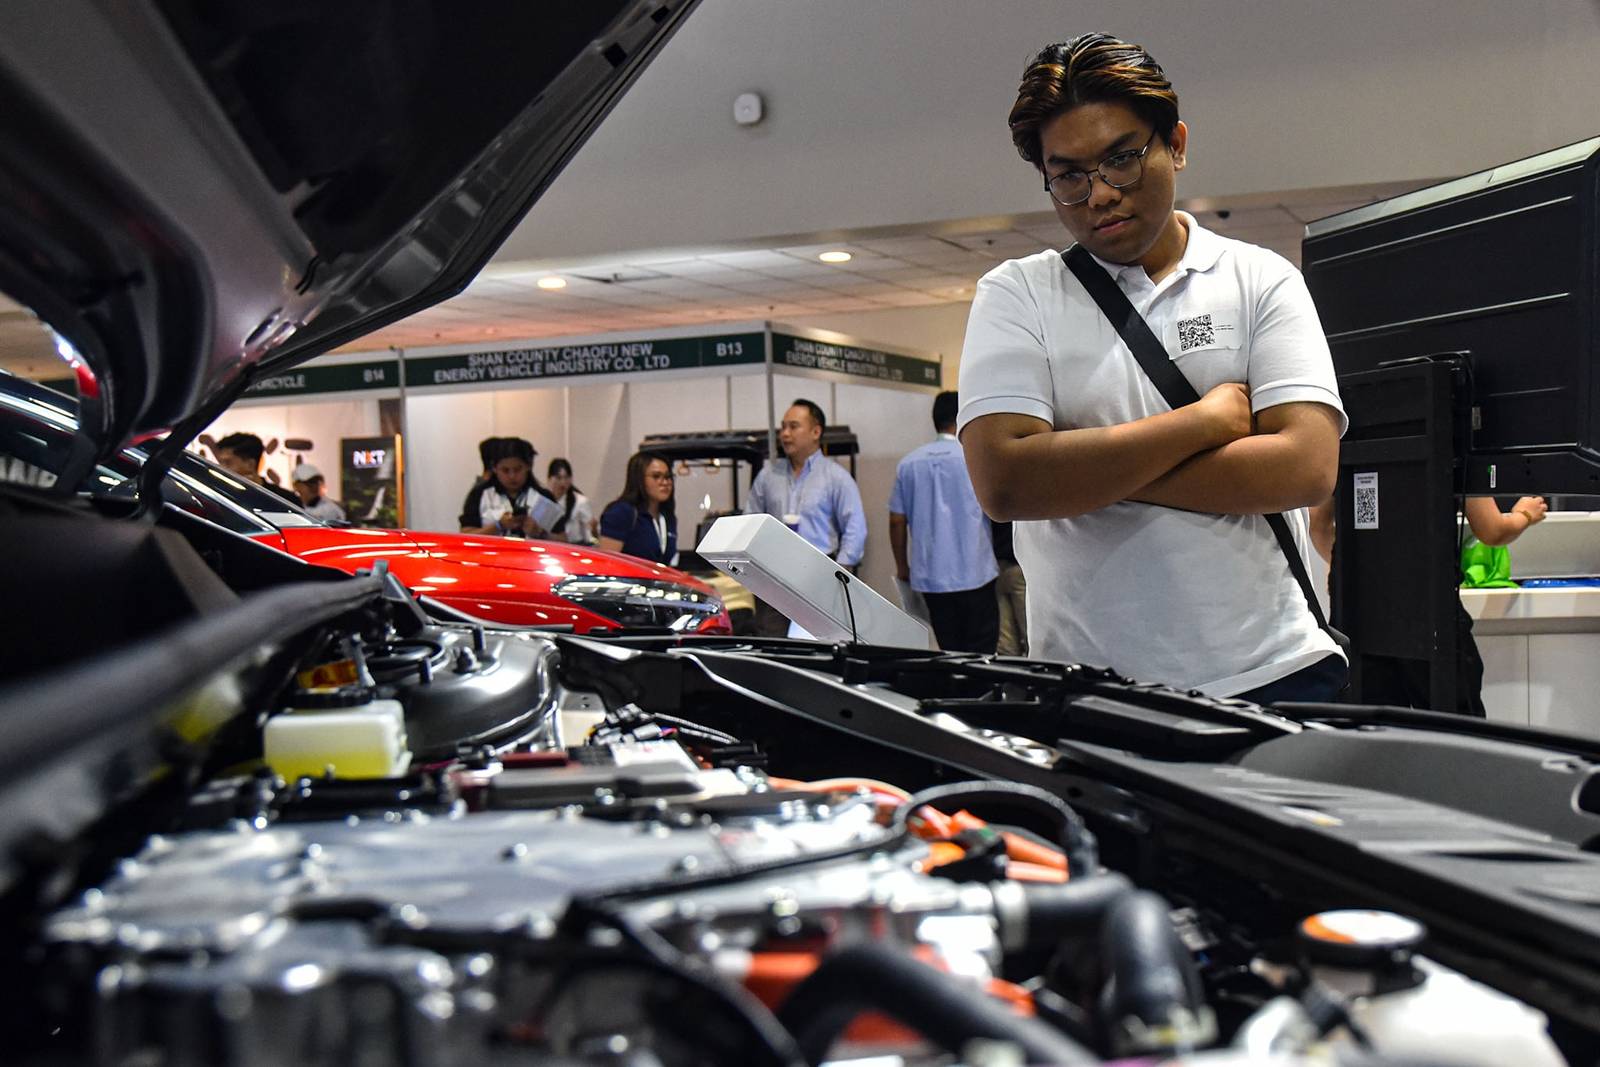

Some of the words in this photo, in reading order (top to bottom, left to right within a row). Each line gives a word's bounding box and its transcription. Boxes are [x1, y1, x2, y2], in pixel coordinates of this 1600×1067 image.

[468, 353, 503, 367] SHAN
[506, 349, 559, 364] COUNTY
[562, 345, 618, 361] CHAOFU
[621, 343, 653, 357] NEW
[716, 342, 743, 357] B13
[433, 367, 486, 383] ENERGY
[488, 363, 542, 379] VEHICLE
[545, 358, 611, 374] INDUSTRY
[645, 355, 671, 369] LTD
